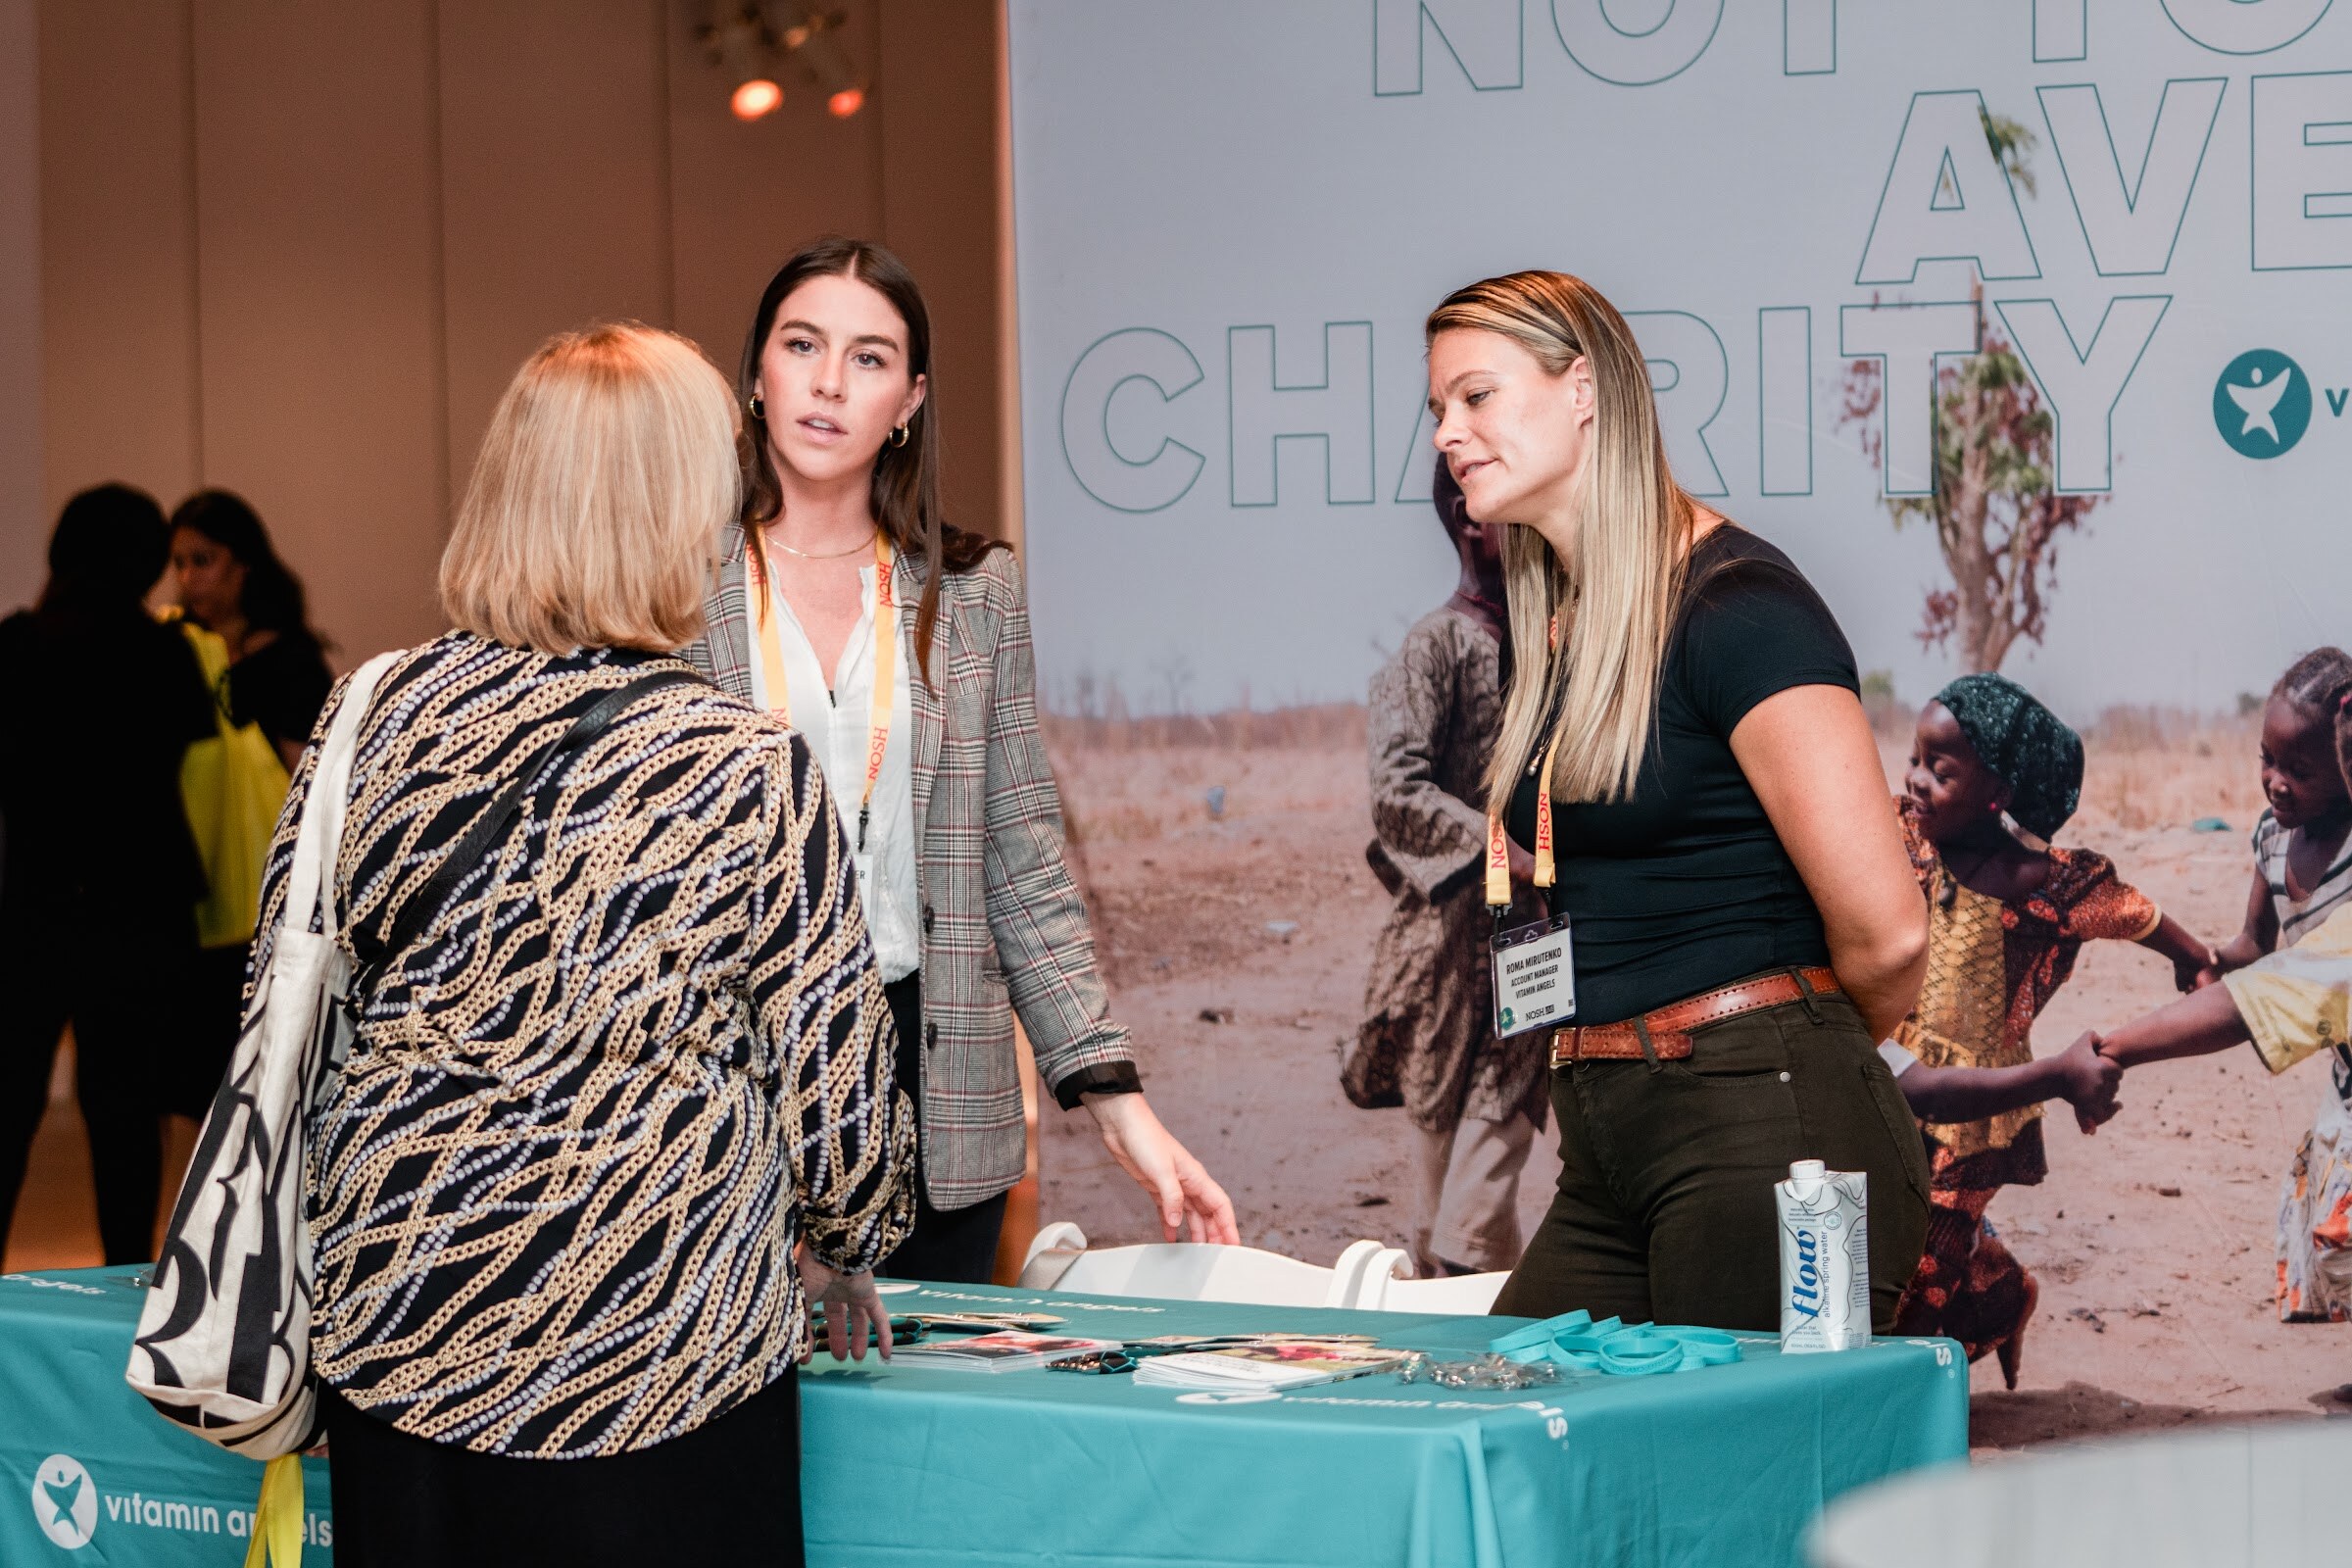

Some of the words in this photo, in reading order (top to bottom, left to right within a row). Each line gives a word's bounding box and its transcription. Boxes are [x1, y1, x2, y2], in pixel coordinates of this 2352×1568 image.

[1061, 295, 2173, 514] CHRITY
[868, 726, 888, 780] NOSH
[1539, 792, 1549, 851] NOSH
[1506, 959, 1524, 975] ROMA
[1525, 947, 1562, 968] MIRUTENKO
[1511, 972, 1534, 988] ACCOUNT
[1534, 964, 1559, 979] MANAGER
[1516, 985, 1536, 1000] VITAMIN
[1537, 978, 1555, 993] ANGELS
[1791, 1228, 1820, 1319] flow
[1821, 1256, 1831, 1284] spring
[1822, 1285, 1831, 1318] alkaline
[105, 1493, 220, 1535] vitamin
